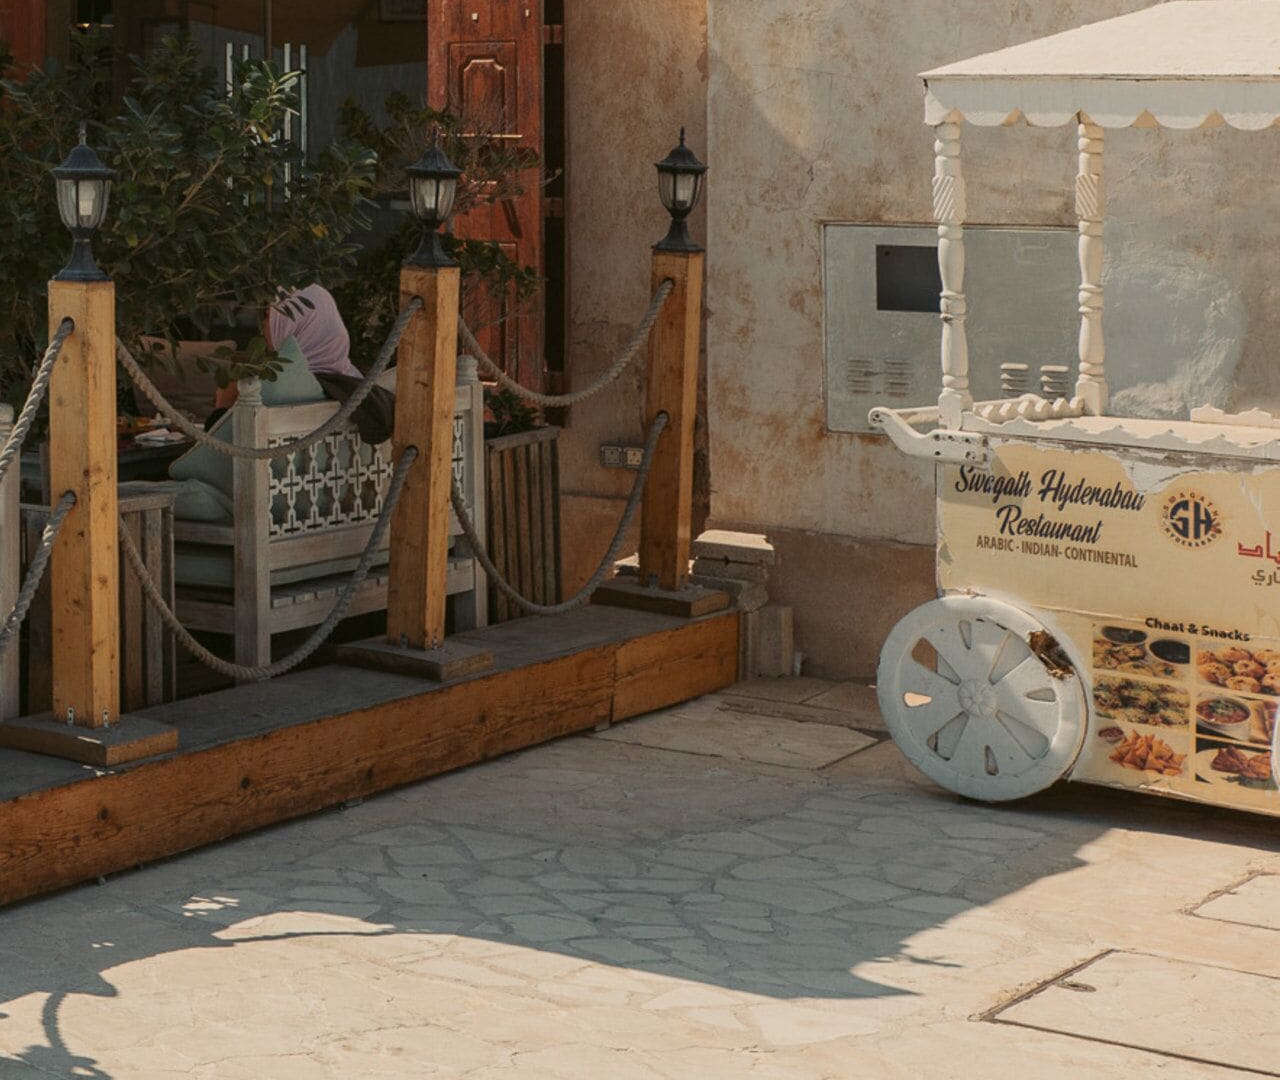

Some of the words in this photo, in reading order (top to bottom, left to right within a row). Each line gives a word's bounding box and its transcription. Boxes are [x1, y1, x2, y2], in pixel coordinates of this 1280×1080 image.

[955, 465, 1033, 504] Swagath
[996, 504, 1103, 545] Restaurant
[976, 535, 1014, 552] ARABIC
[1064, 545, 1139, 568] CONTINENTAL
[1145, 617, 1184, 633] Chaat
[1188, 623, 1198, 634] &
[1201, 625, 1250, 642] Snacks
